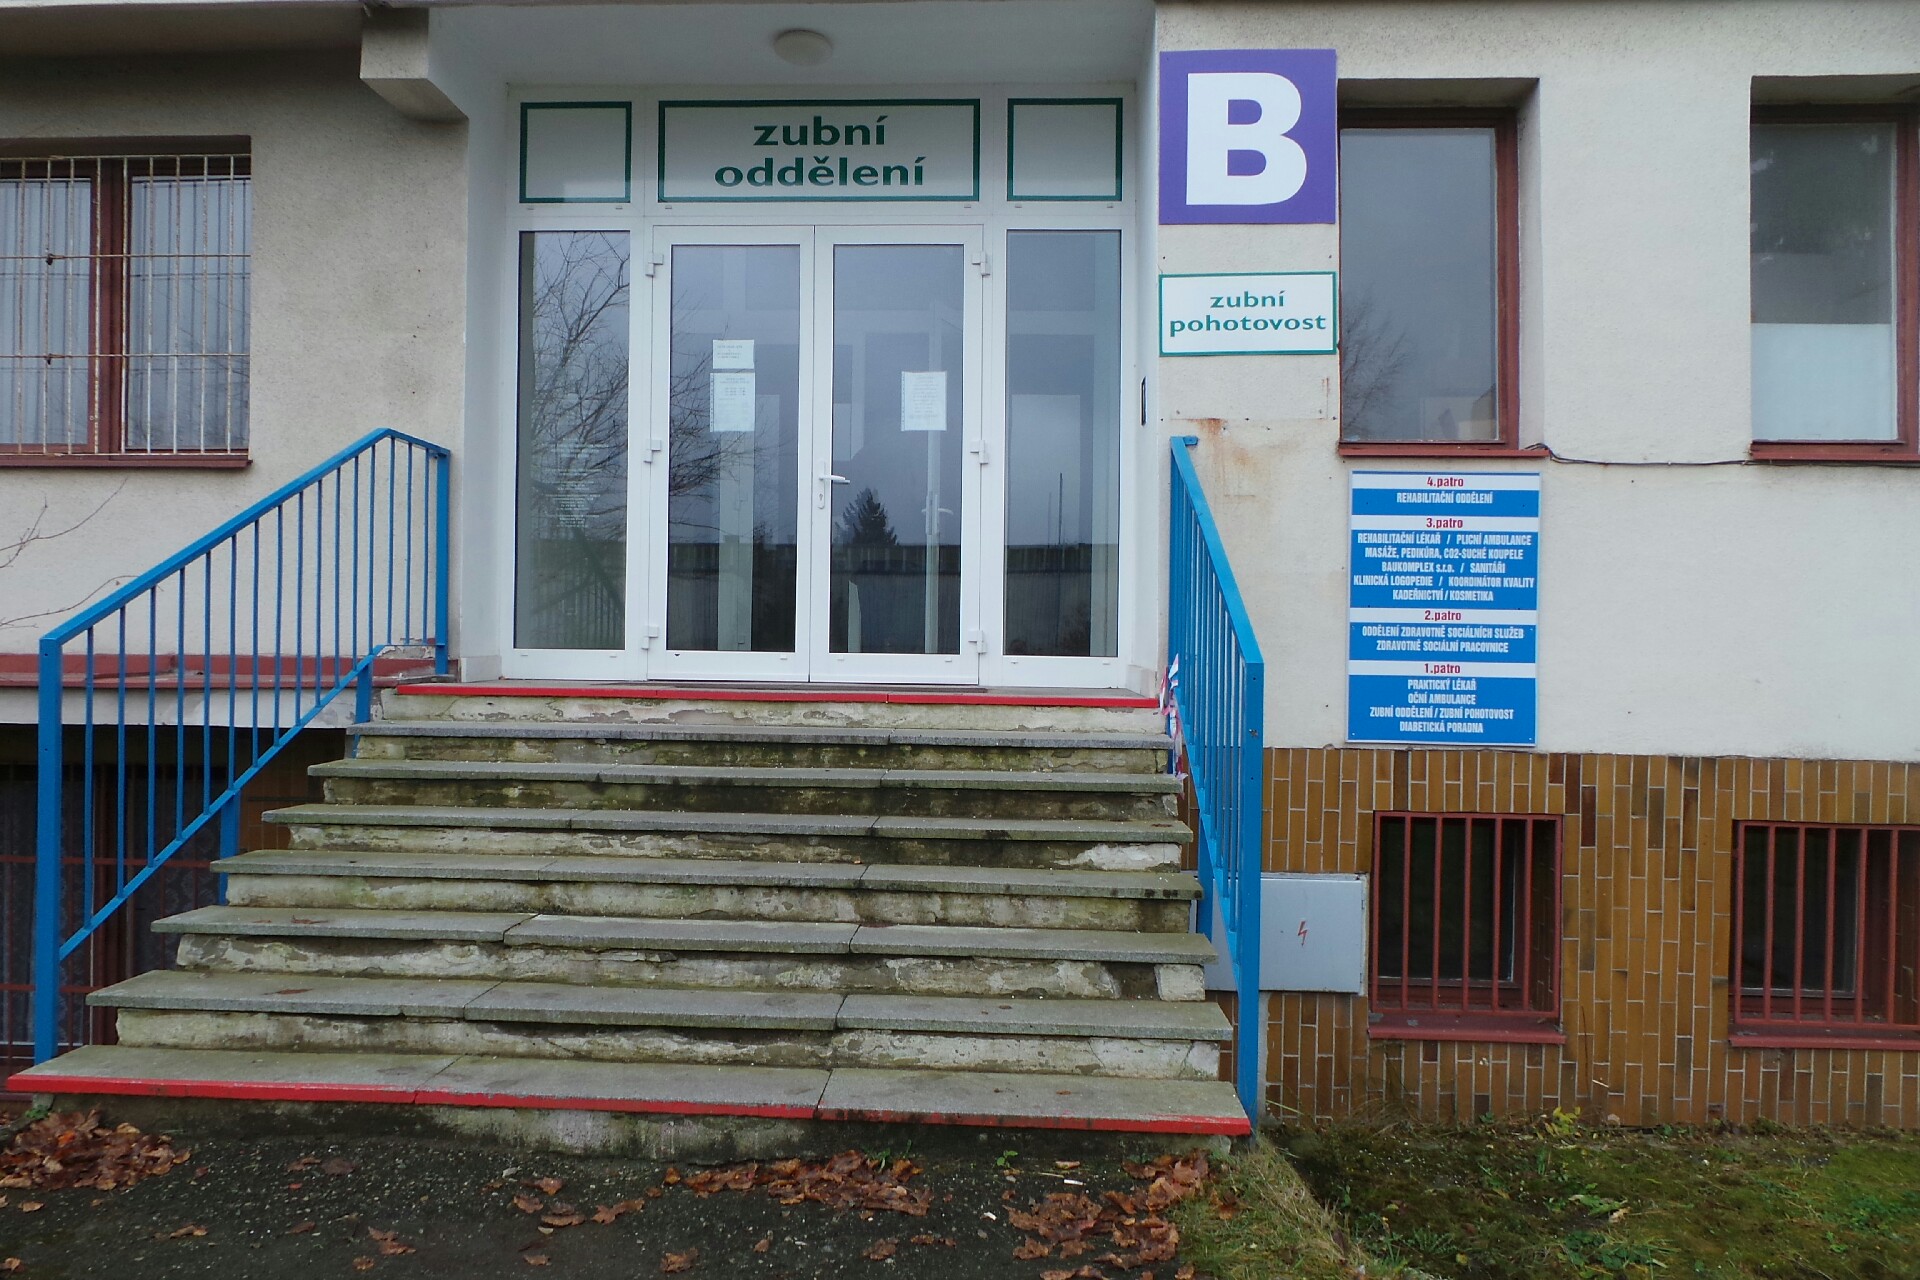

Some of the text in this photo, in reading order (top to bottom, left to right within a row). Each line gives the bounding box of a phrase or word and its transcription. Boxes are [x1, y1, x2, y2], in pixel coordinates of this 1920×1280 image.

[753, 115, 888, 146] zubní
[1186, 72, 1307, 205] B
[714, 155, 926, 187] oddělení
[1210, 290, 1286, 309] zubní
[1170, 314, 1326, 338] pohotovost
[1427, 477, 1464, 488] 4.patro
[1397, 491, 1493, 504] REHABILITAČNÍ ODDĚLENÍ
[1426, 517, 1463, 529] 3.patro
[1358, 532, 1532, 546] REHABILITAČNÍ LÉKAŘ / PLICNÍ AMBULANCE
[1365, 545, 1399, 559] MASÁŽE,
[1488, 549, 1524, 560] KOUPELE
[1382, 561, 1506, 574] BAUKOMPLEX s.r.o. / SANITÁŘI
[1354, 573, 1534, 588] KLINICKÁ LOGOPEDIE / KOORDINÁTOR KVALITY
[1392, 588, 1444, 600] KADEŘNICTVÍ
[1450, 590, 1494, 601] KOSMETIKA
[1424, 610, 1461, 621] 2.patro
[1362, 624, 1524, 639] ODDĚLENÍ ZDRAVOTNĚ SOCIÁLNÍCH SLUŽEB
[1376, 639, 1509, 653] ZDRAVOTNĚ SOCIÁLNÍ PRACOVNICE
[1424, 663, 1460, 674] 1.patro
[1408, 678, 1476, 690] PRAKTICKÝ LÉKAŘ
[1408, 691, 1476, 705] OČNÍ AMBULANCE
[1370, 705, 1394, 717] ZUBNÍ
[1395, 705, 1433, 718] ODDĚLENÍ
[1439, 706, 1463, 718] ZUBNÍ
[1464, 708, 1514, 719] POHOTOVOST
[1400, 720, 1484, 733] DIABETICKÁ PORADNA
